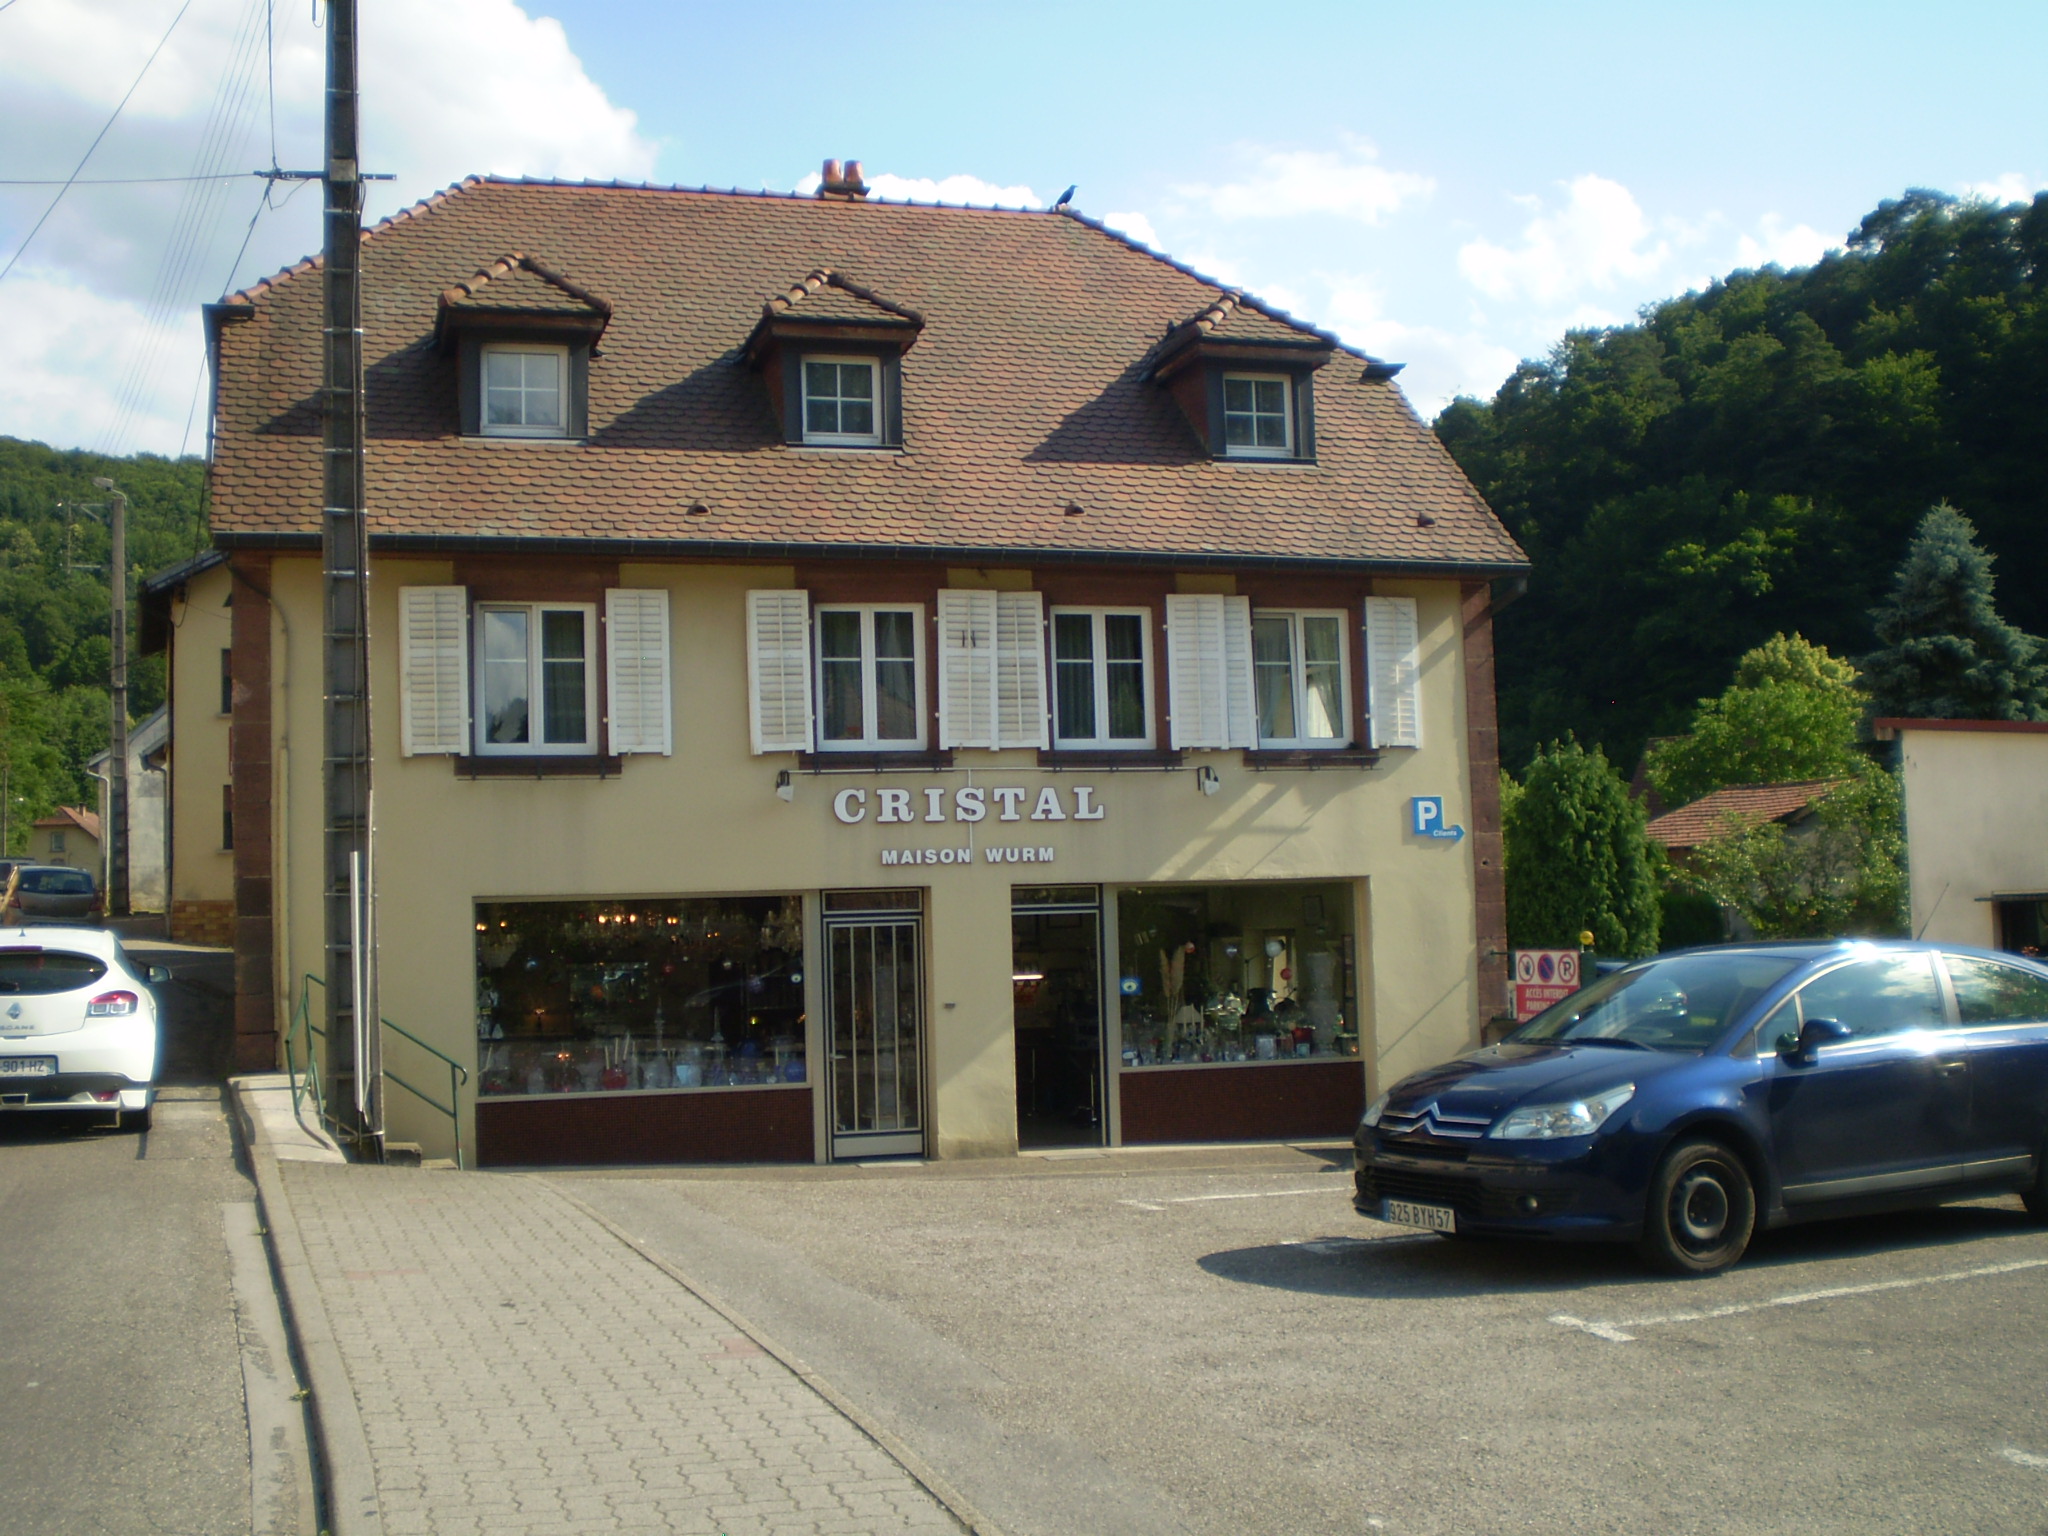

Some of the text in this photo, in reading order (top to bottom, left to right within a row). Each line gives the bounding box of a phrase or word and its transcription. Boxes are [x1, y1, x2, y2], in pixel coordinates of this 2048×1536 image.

[833, 786, 1105, 823] CRISTAL
[1418, 801, 1437, 830] P
[881, 847, 1055, 865] MAISON WURM
